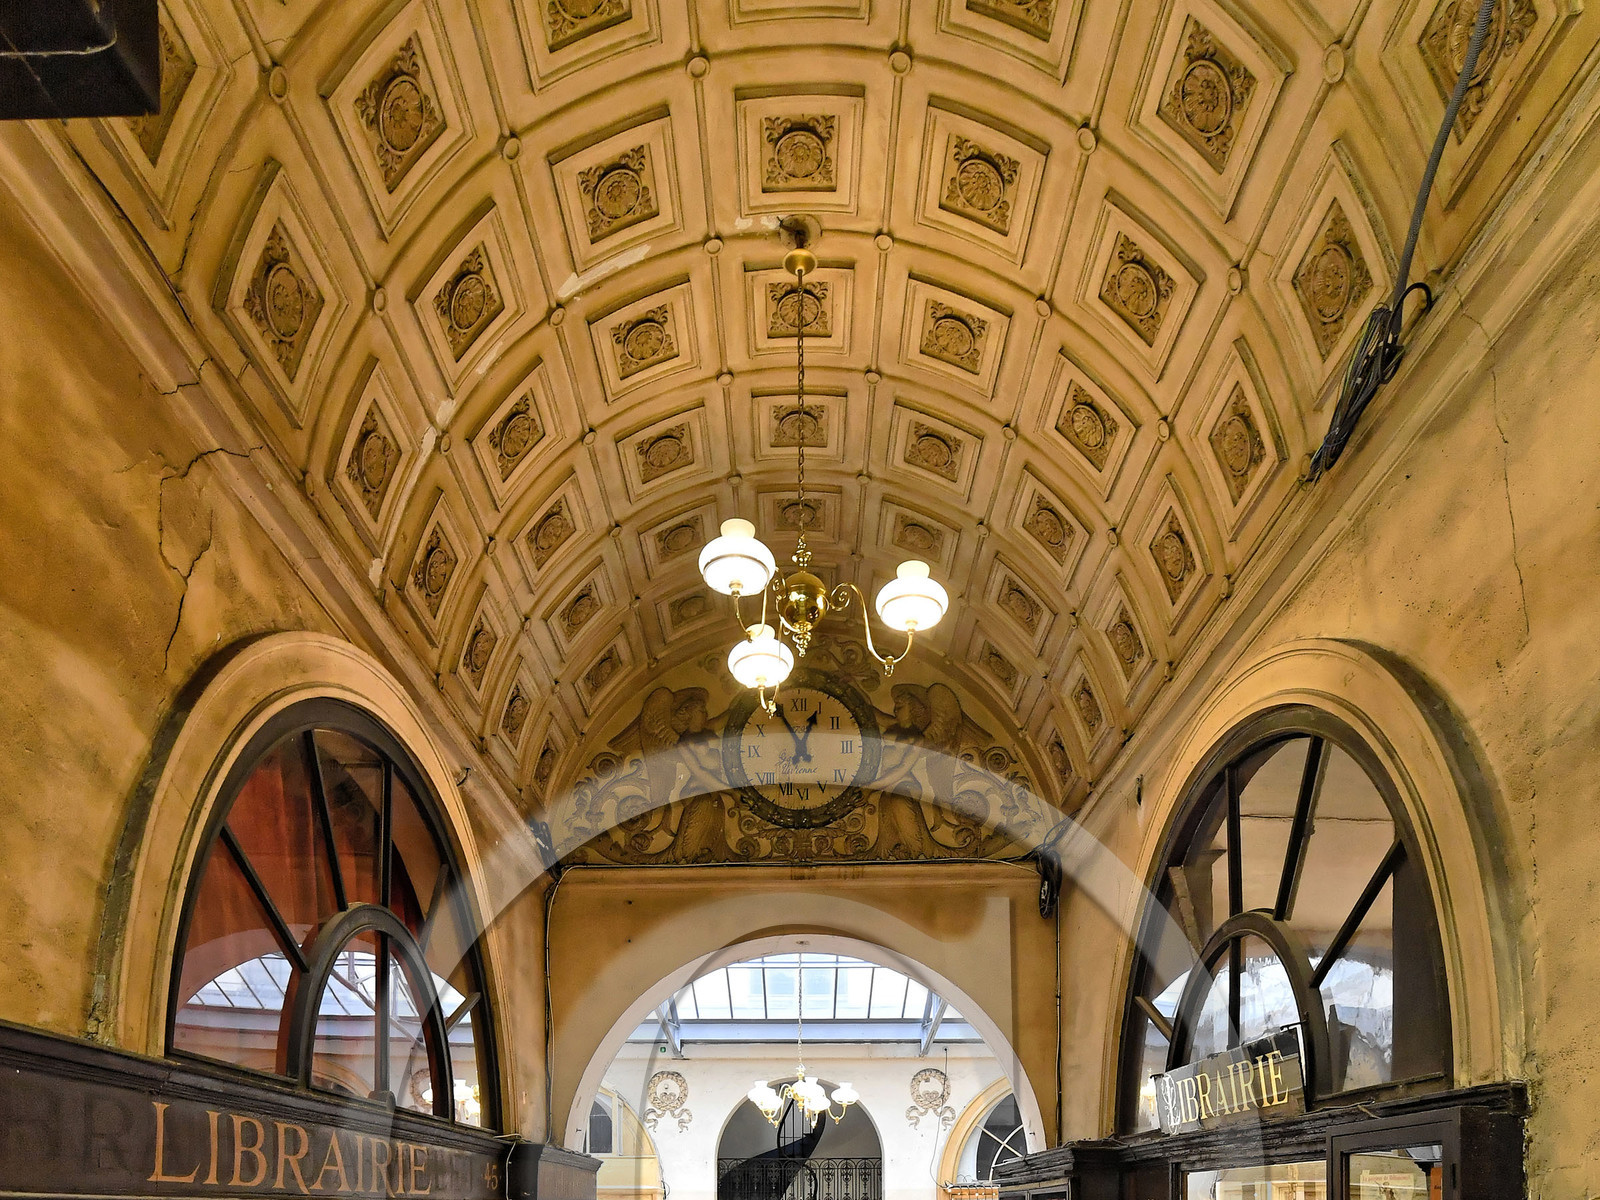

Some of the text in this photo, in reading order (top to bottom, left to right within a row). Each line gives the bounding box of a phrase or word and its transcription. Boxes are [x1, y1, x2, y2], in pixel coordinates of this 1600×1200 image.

[791, 698, 807, 711] XII
[830, 716, 840, 729] II
[756, 724, 766, 737] X
[748, 745, 761, 758] IX
[841, 740, 853, 754] III
[755, 772, 775, 785] VIII
[833, 769, 847, 783] IV
[778, 782, 793, 796] VII
[817, 780, 827, 793] V
[797, 788, 809, 801] VI
[1160, 1050, 1289, 1135] LIBRAIRIE
[146, 1101, 432, 1196] LIBRAIRIE
[483, 1161, 498, 1190] 45
